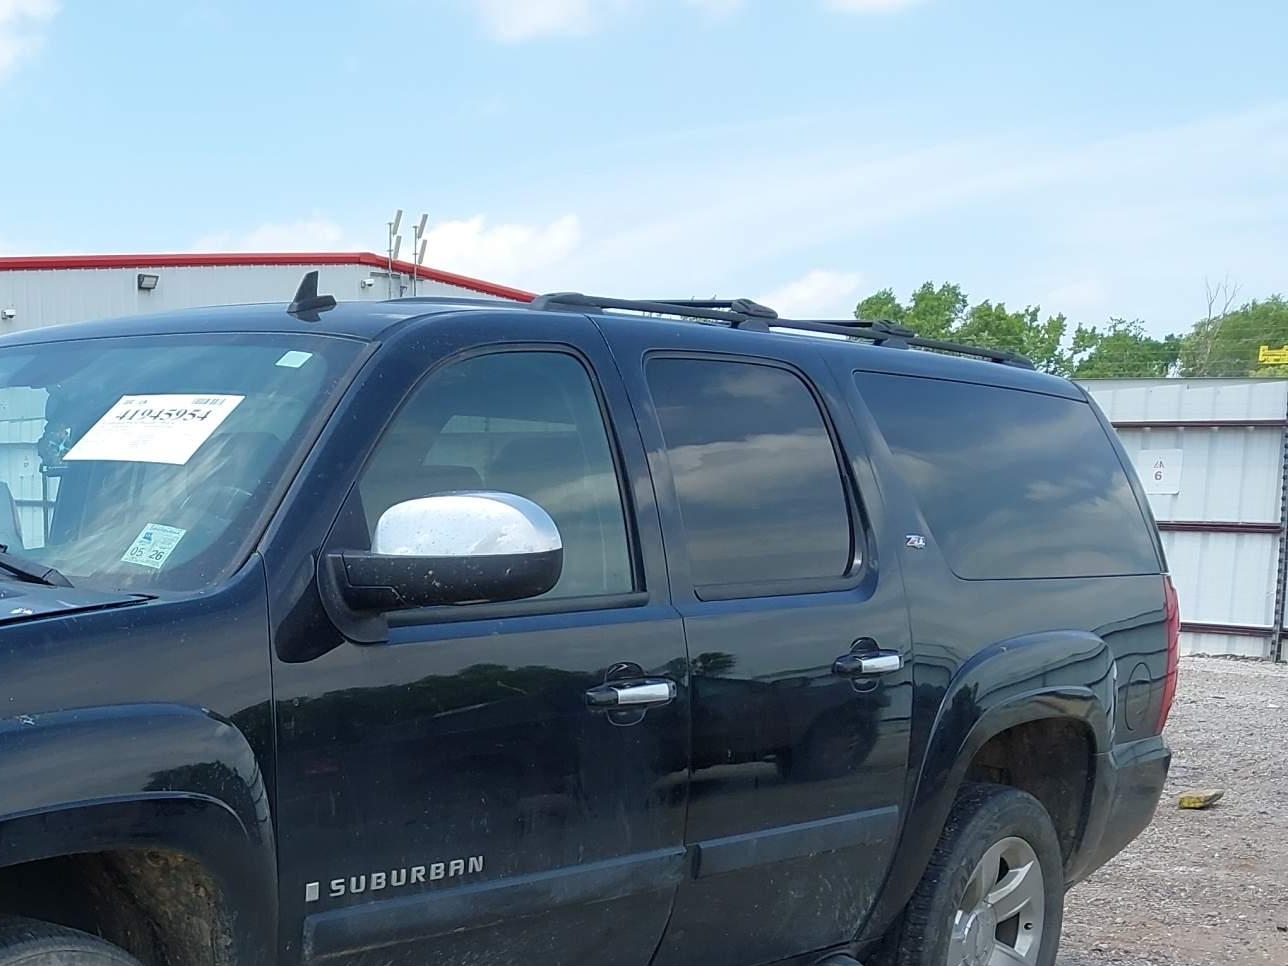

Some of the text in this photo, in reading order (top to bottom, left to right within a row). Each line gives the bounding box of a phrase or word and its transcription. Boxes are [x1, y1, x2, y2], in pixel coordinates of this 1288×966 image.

[115, 408, 213, 421] 41945954
[1154, 470, 1163, 481] 6
[130, 546, 165, 561] 05 26
[329, 855, 484, 897] SUBURBAN
